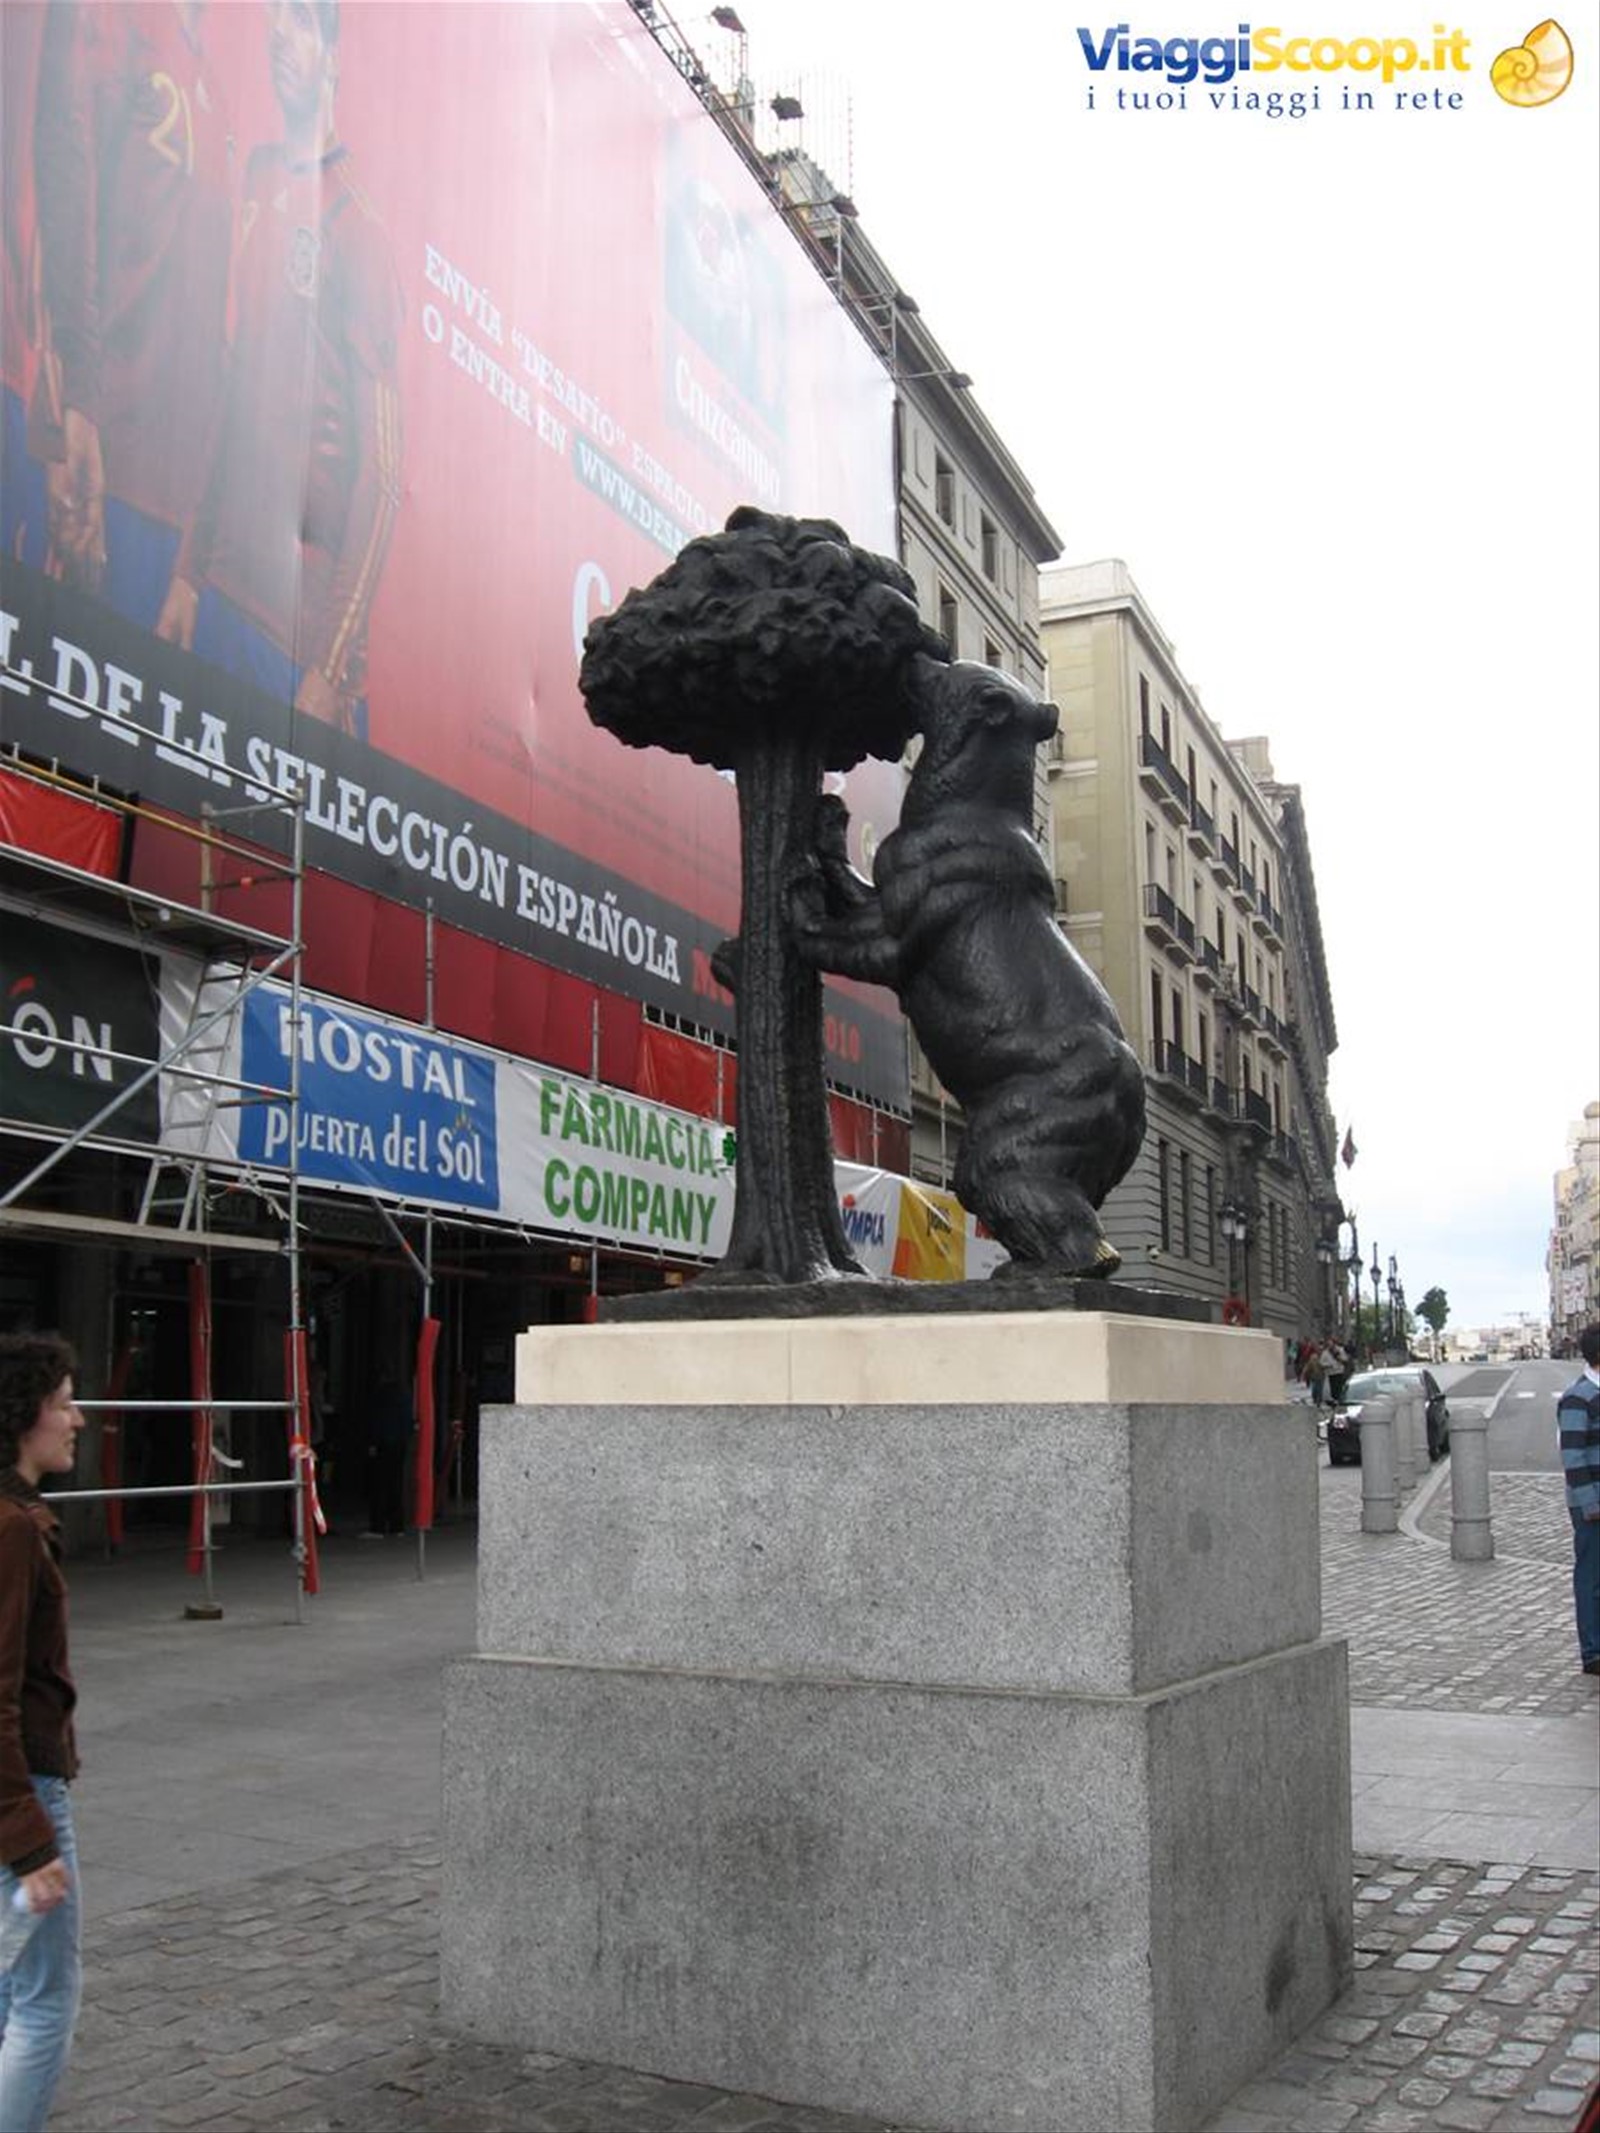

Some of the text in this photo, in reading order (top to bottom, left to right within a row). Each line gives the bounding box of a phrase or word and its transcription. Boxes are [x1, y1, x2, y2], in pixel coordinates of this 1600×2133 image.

[424, 244, 503, 346] ENVÍA
[422, 304, 443, 343] O
[449, 324, 532, 428] ENTRA
[536, 408, 568, 456] EN
[47, 637, 143, 746] DE
[155, 690, 232, 788] LA
[245, 736, 511, 910] SELECCIÓN
[516, 864, 680, 984] ESPAÑOLA
[278, 1006, 476, 1106] HOSTAL
[437, 1128, 486, 1186] Sol
[538, 1078, 719, 1178] FARMACIA
[543, 1158, 717, 1245] COMPANY
